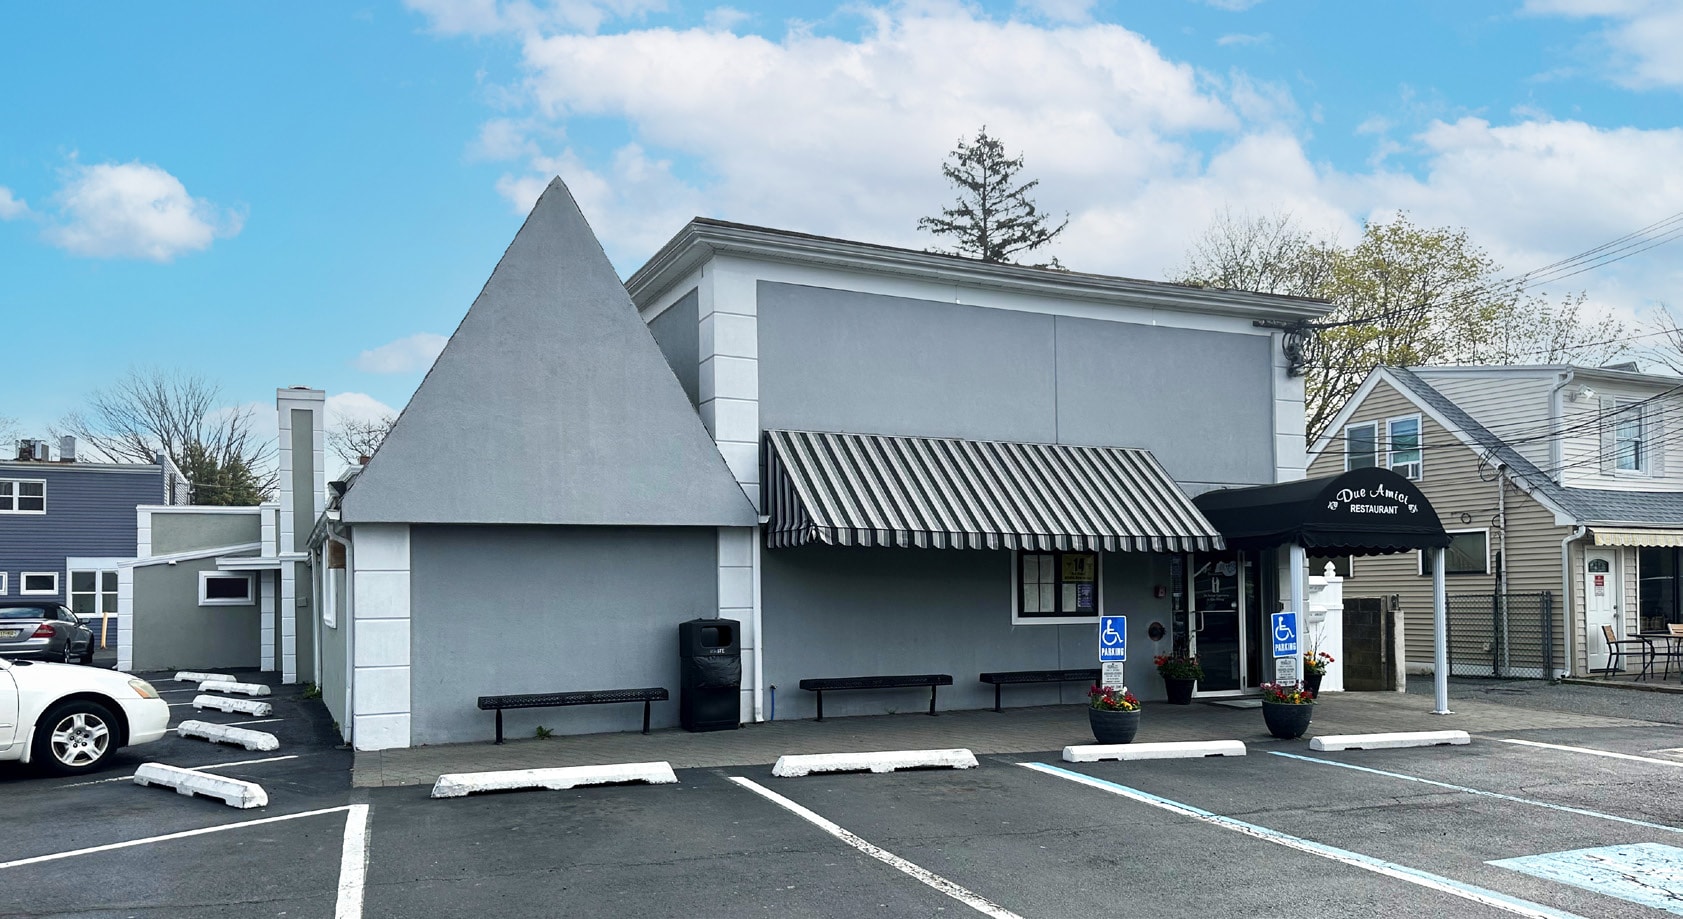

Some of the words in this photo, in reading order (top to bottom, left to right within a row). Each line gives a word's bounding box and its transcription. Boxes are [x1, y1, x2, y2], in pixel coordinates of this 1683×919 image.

[1337, 488, 1366, 503] Due
[1369, 484, 1408, 505] Amici
[1350, 504, 1398, 514] RESTAURANT
[1101, 647, 1124, 656] PARKING
[1275, 642, 1296, 652] PARKING
